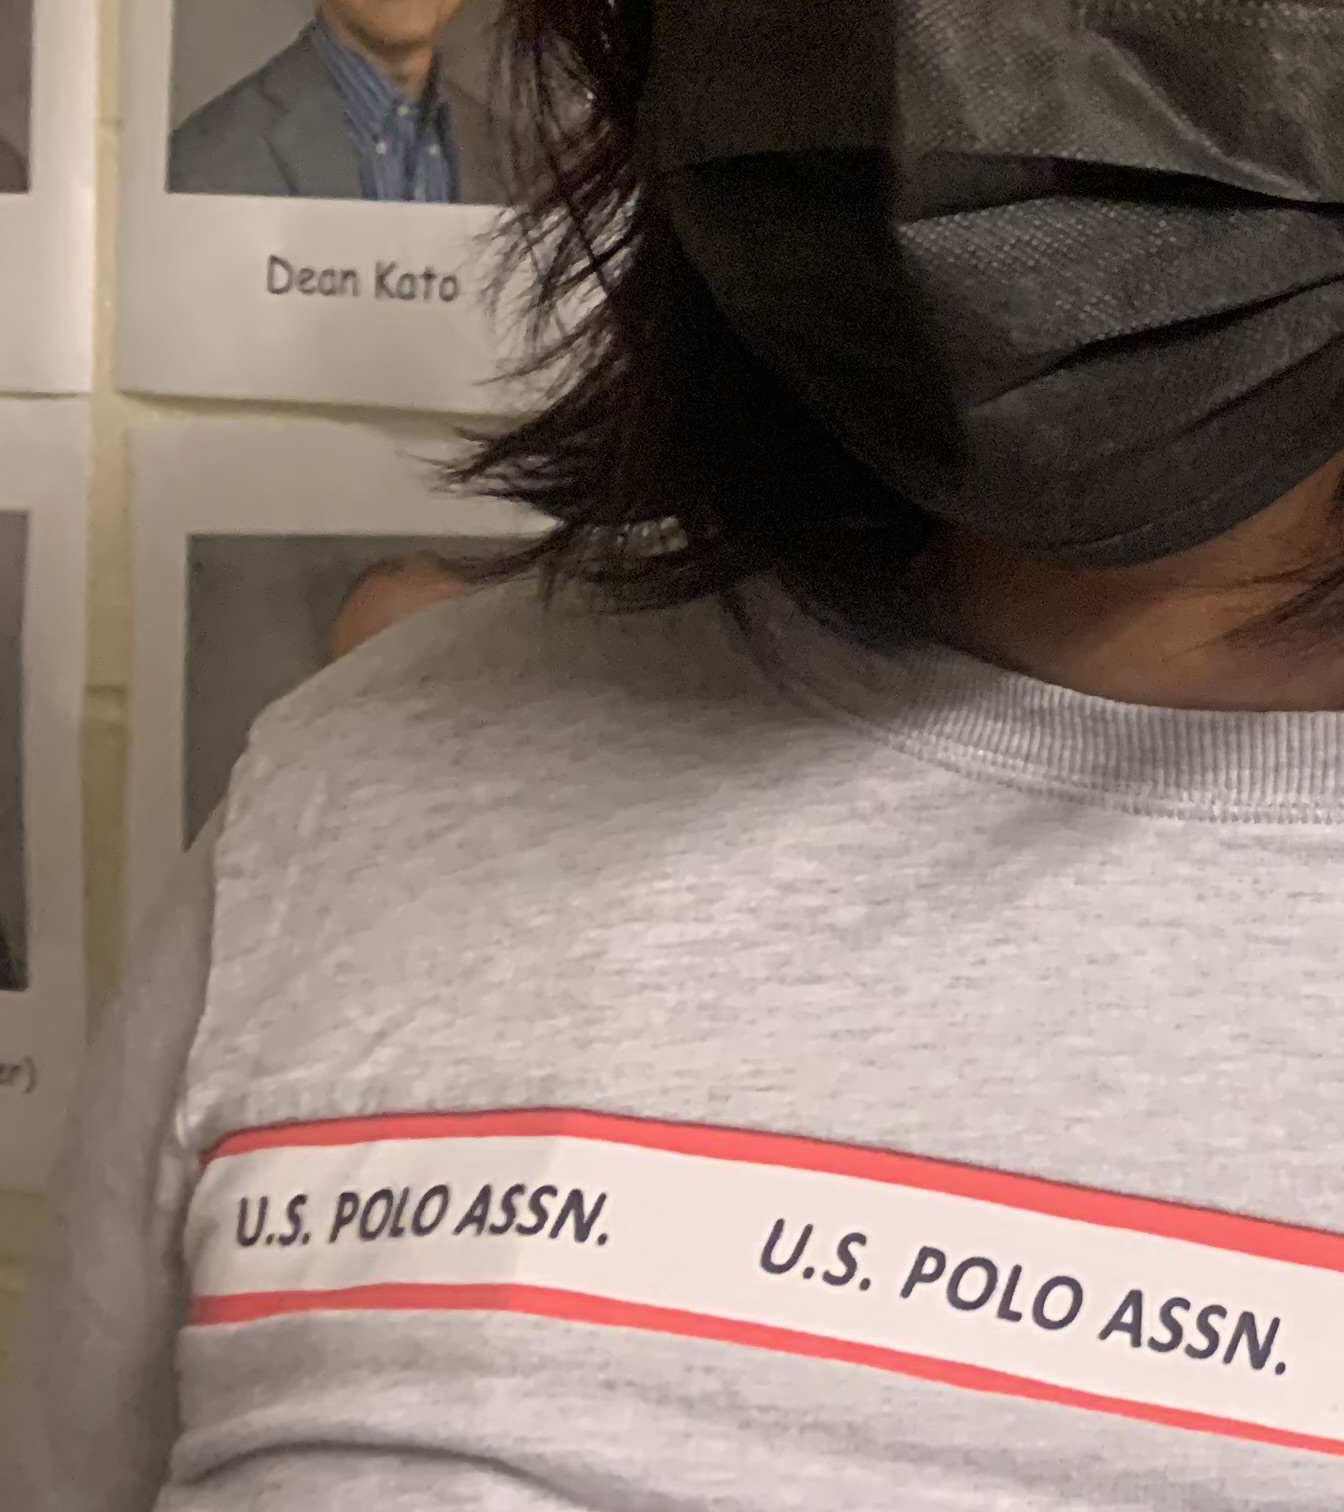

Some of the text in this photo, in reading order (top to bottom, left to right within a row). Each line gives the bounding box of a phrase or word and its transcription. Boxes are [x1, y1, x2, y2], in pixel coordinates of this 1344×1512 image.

[266, 253, 459, 303] Dean Kato
[235, 1183, 611, 1248] U.S. POLO ASSN.
[759, 1218, 1287, 1376] U.S. POLO ASSN.
